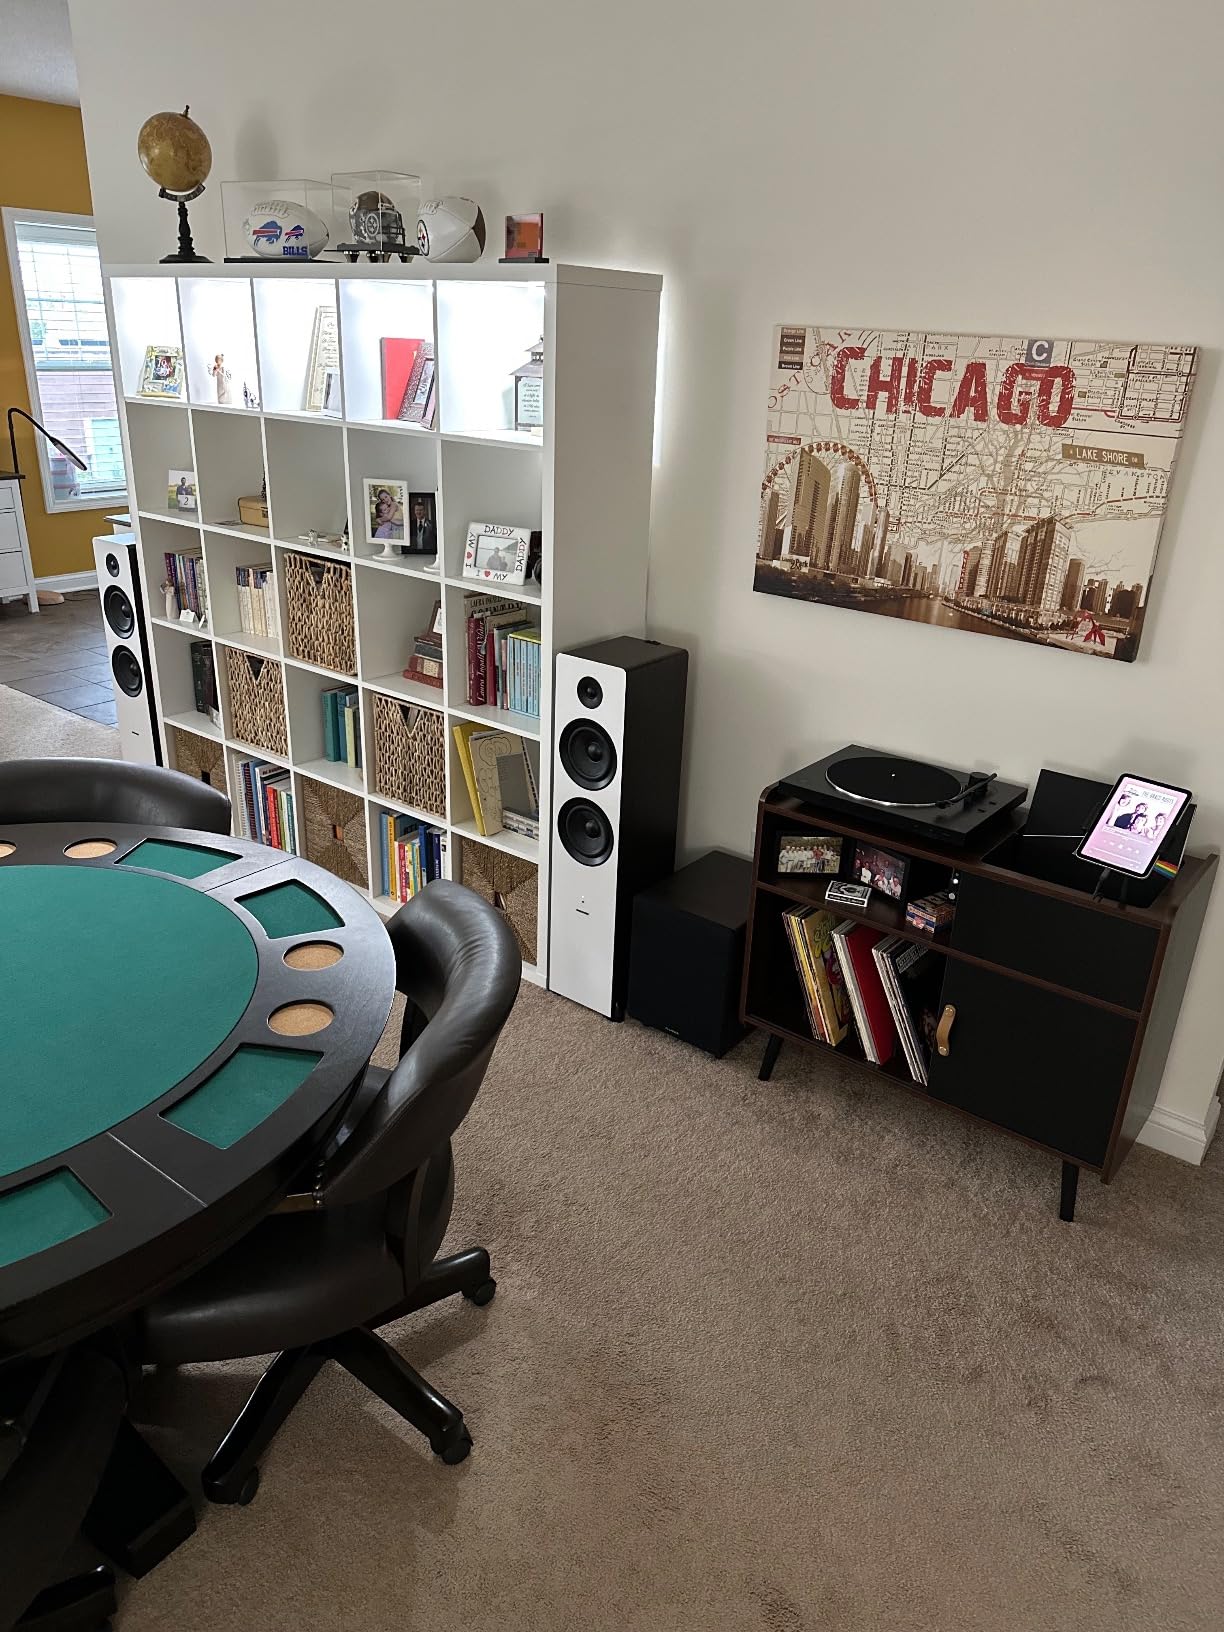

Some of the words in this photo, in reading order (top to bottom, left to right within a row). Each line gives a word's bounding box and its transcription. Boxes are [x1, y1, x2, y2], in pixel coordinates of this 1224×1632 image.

[283, 246, 308, 256] BILLS
[1032, 340, 1049, 361] C
[831, 346, 1076, 428] CHICAGO
[1076, 447, 1098, 461] LAKE
[1102, 451, 1129, 465] SHORE
[184, 497, 189, 506] 2
[484, 525, 515, 536] DADDY
[516, 537, 527, 572] DADDY
[493, 572, 508, 581] MY
